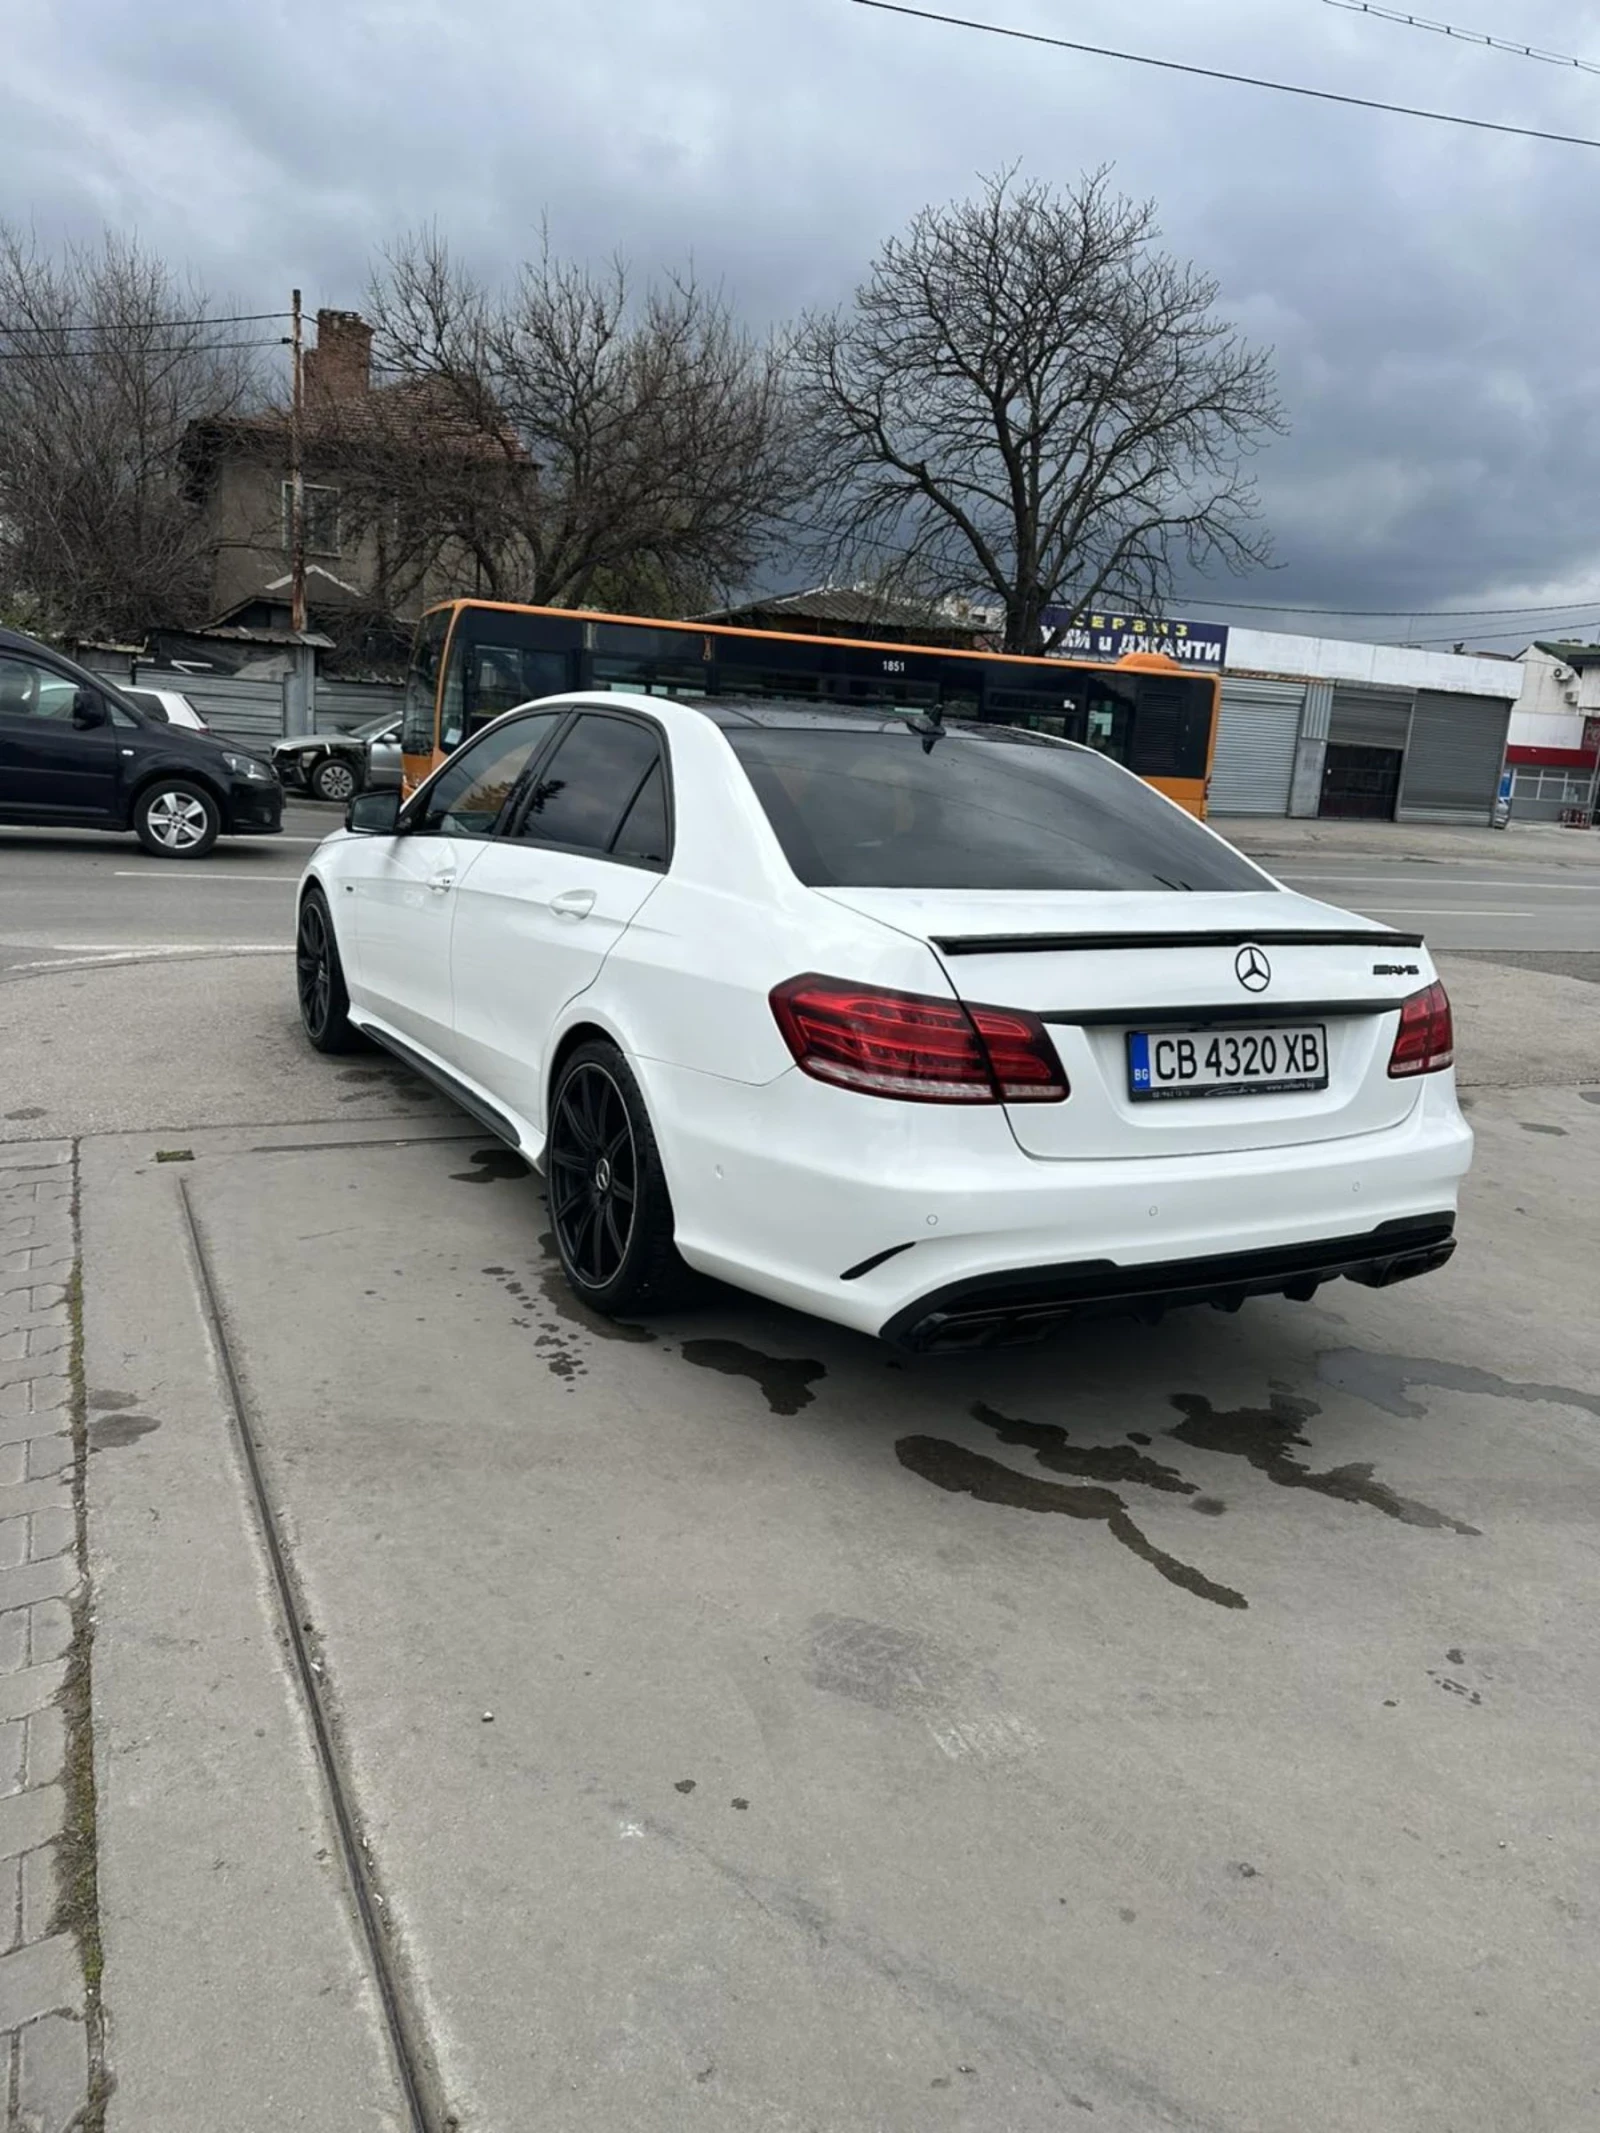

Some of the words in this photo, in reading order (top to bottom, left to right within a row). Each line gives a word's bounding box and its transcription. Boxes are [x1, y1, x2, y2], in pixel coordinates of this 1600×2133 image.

[882, 660, 905, 671] 1851
[1155, 1039, 1197, 1081] CB
[1204, 1035, 1277, 1078] 4320
[1283, 1033, 1319, 1073] XB
[1134, 1067, 1149, 1081] BG
